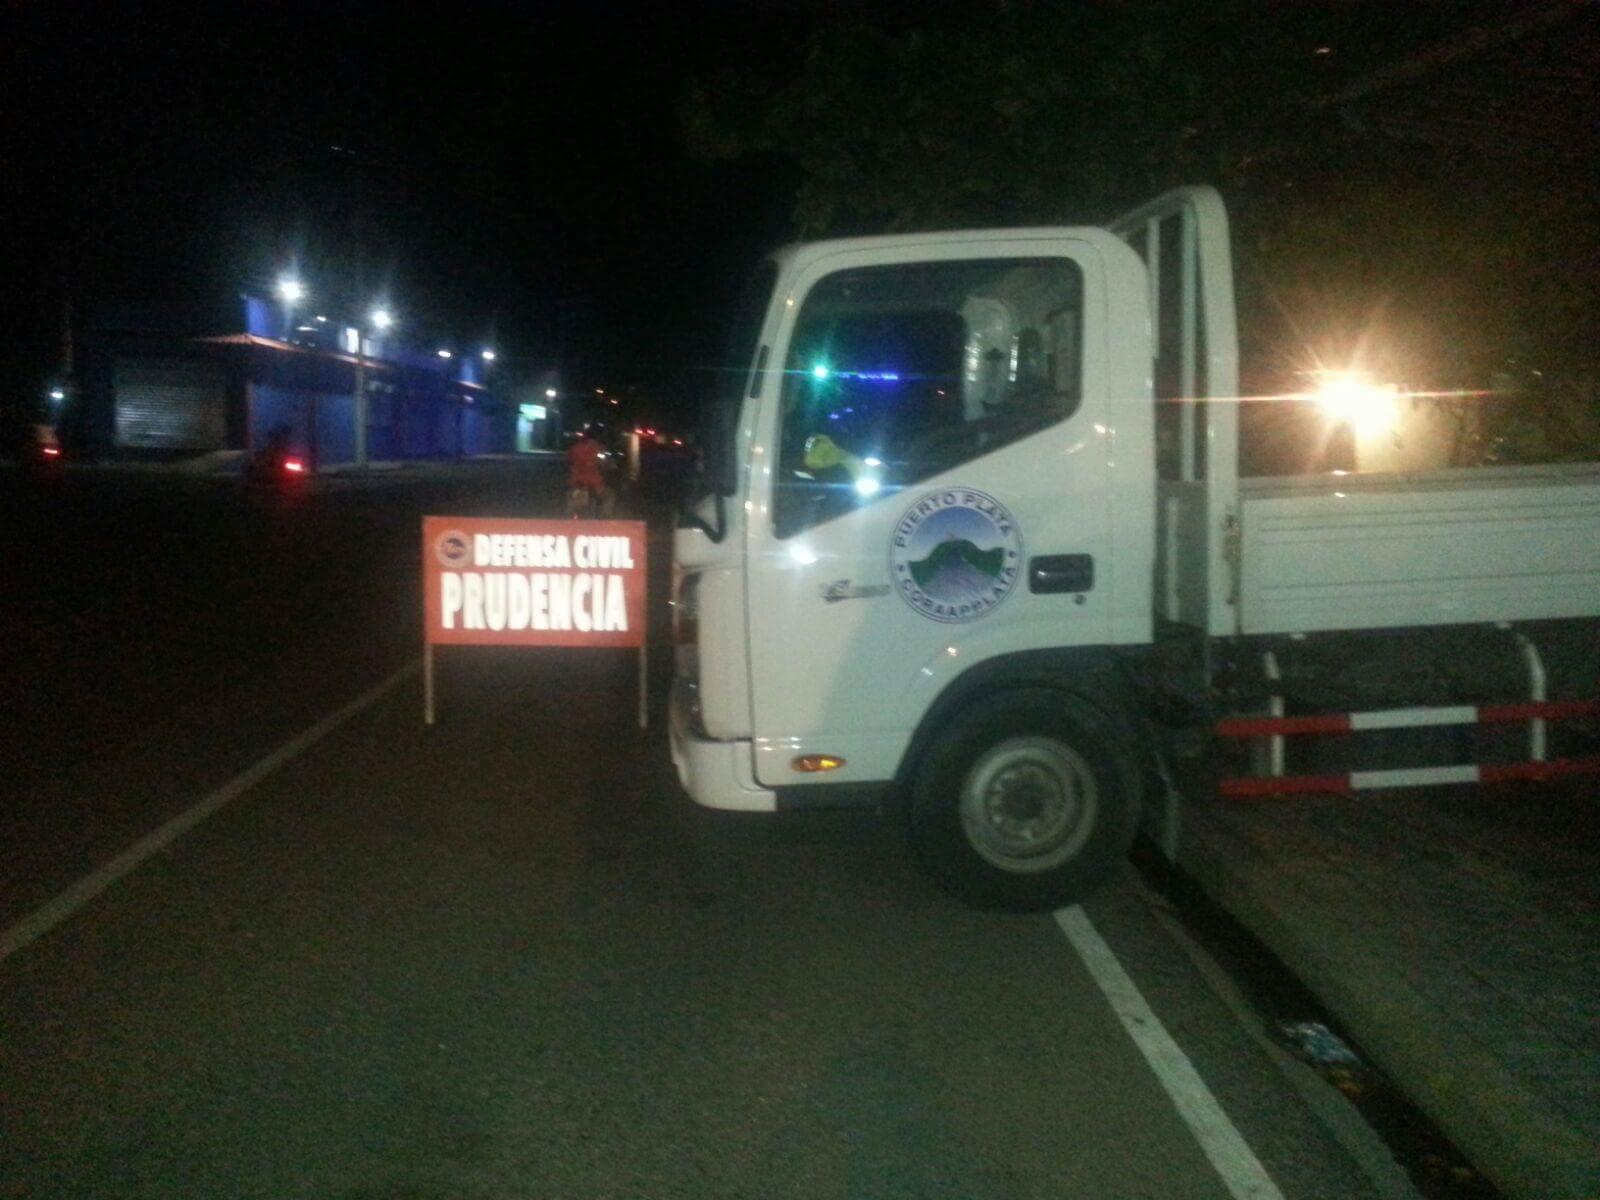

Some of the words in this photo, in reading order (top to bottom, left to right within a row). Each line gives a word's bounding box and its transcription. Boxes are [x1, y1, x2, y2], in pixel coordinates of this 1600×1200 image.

[894, 493, 956, 548] PUERTO
[965, 494, 1012, 534] PLATA
[474, 534, 571, 567] DEFENSA
[574, 535, 634, 569] CIVIL
[440, 572, 628, 632] PRUDENCIA
